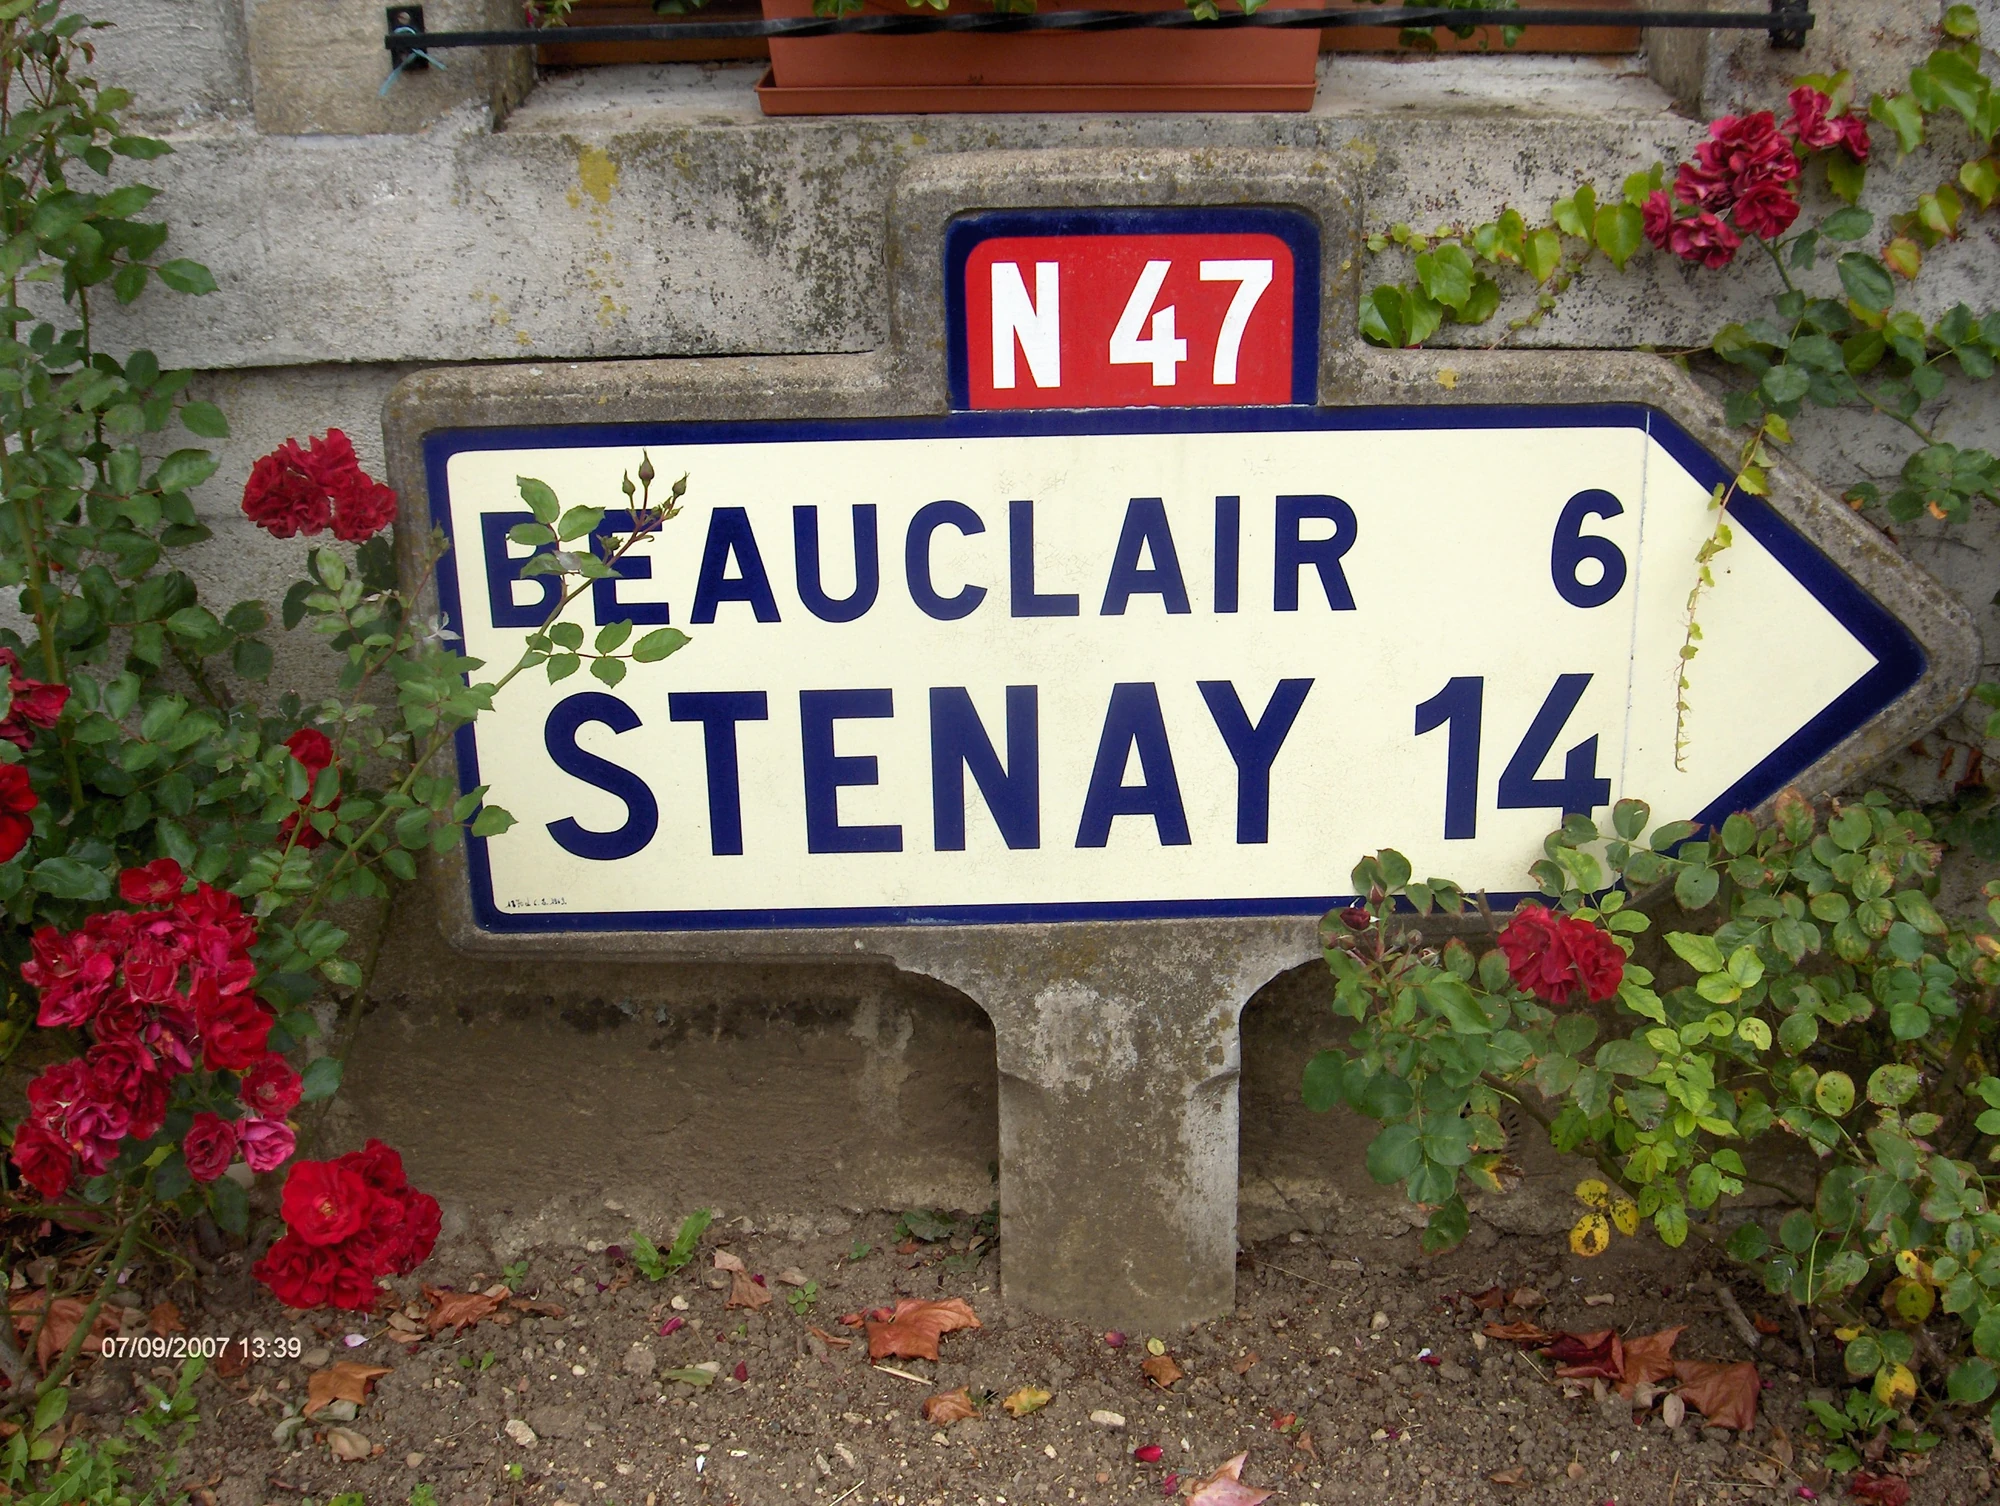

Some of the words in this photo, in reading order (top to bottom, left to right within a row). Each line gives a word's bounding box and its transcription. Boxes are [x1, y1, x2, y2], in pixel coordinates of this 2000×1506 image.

[991, 261, 1061, 389] N
[1109, 259, 1273, 387] 47
[480, 494, 1357, 628] BEAUCLAIR
[1550, 490, 1626, 609] 6
[544, 678, 1313, 860] STENAY
[1414, 673, 1611, 840] 14
